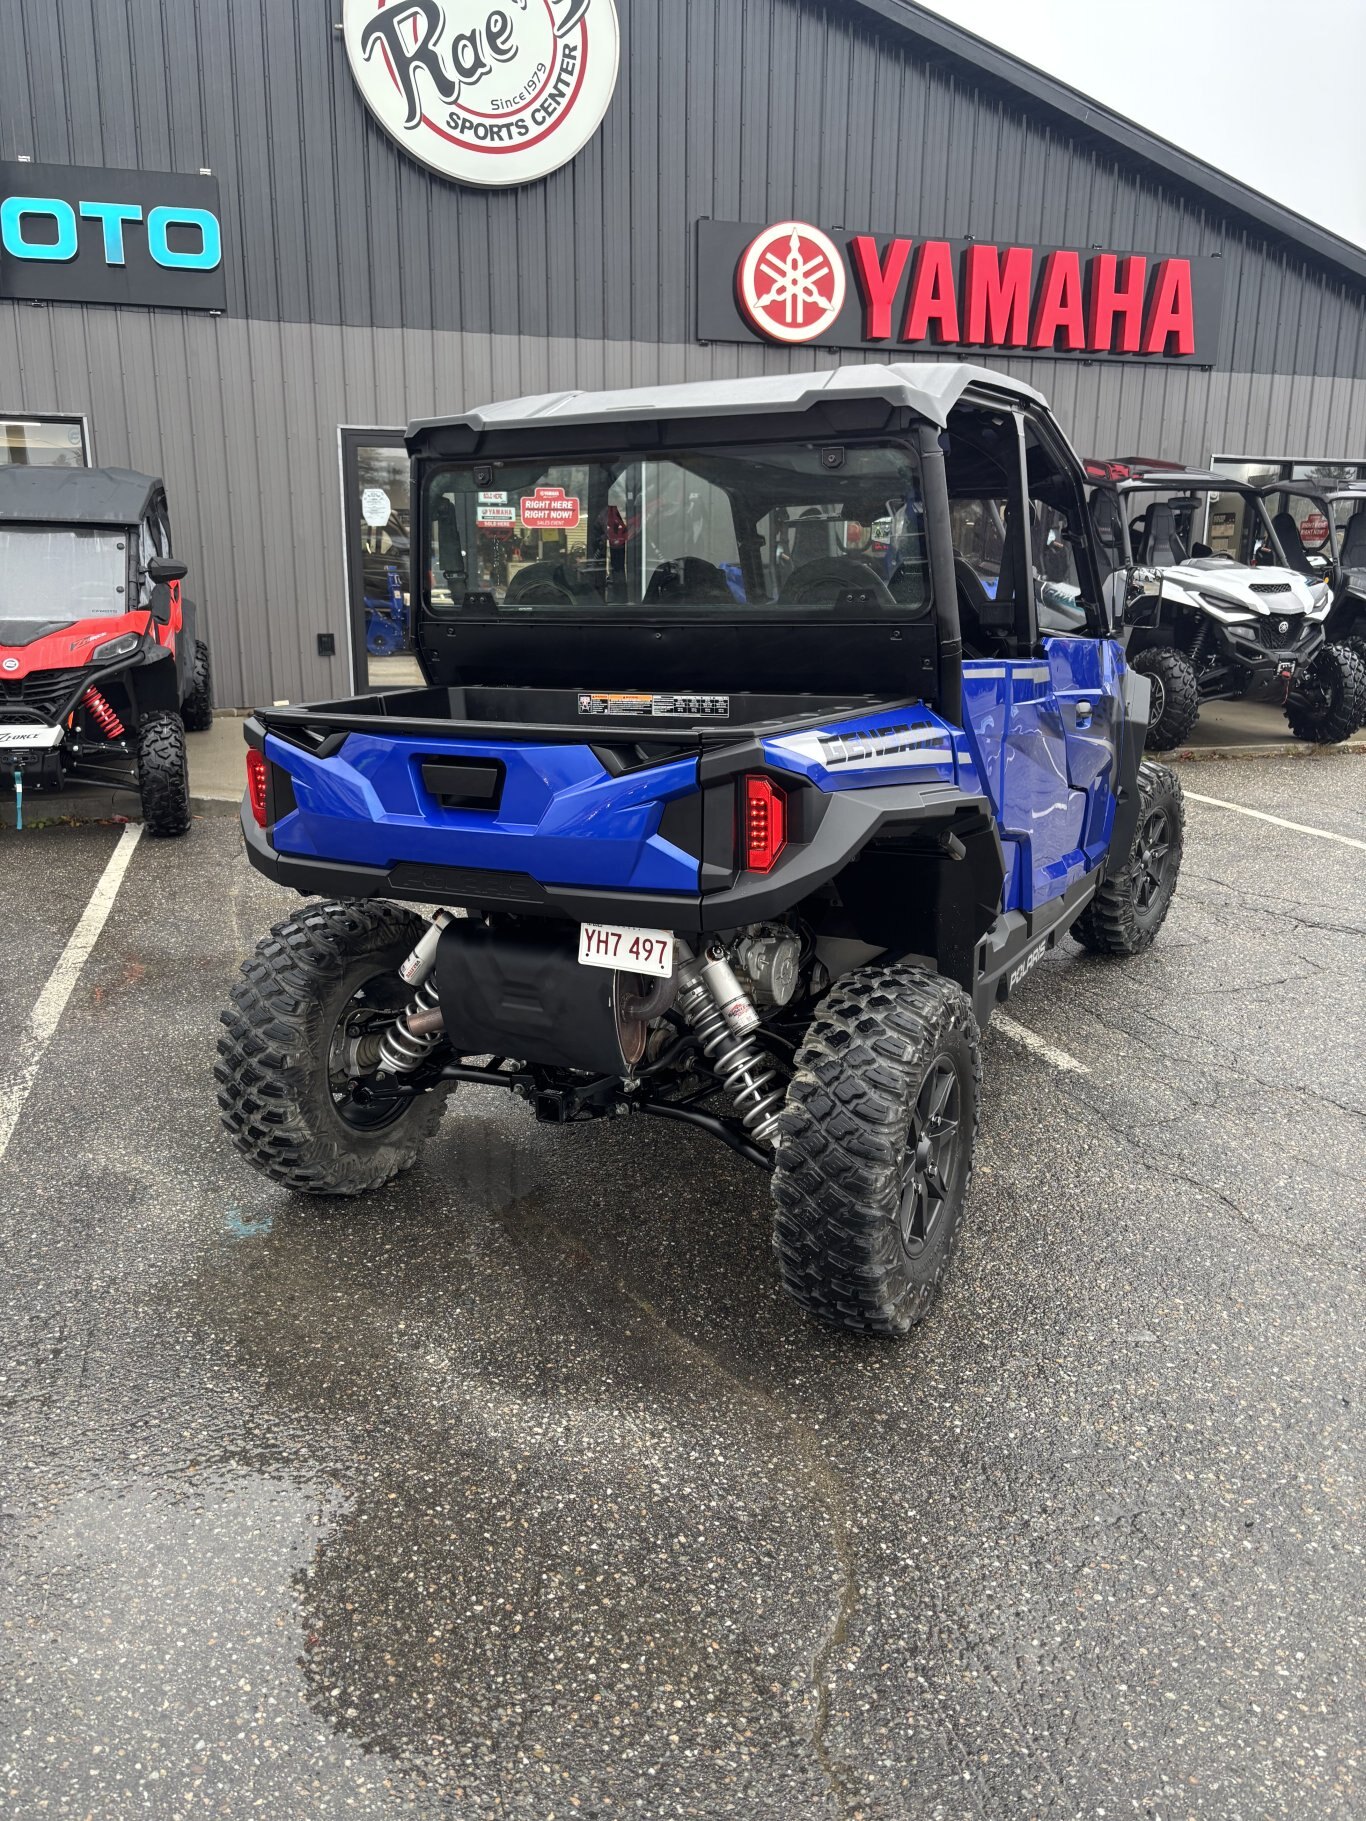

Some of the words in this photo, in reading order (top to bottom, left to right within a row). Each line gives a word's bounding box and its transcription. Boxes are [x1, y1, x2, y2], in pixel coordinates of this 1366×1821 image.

[361, 0, 591, 131] Rae
[491, 91, 526, 111] Since
[525, 62, 547, 95] 1979
[446, 111, 530, 142] SPORTS
[531, 43, 578, 126] CENTER
[852, 235, 1195, 355] YAMAHA
[488, 508, 513, 516] YAMAHA
[524, 511, 549, 519] RIGHT
[550, 511, 573, 519] NOW!
[525, 501, 550, 509] RIGHT
[551, 501, 573, 509] HERE
[584, 928, 622, 957] YH7
[628, 936, 668, 965] 497
[1009, 939, 1046, 991] POLARIS
